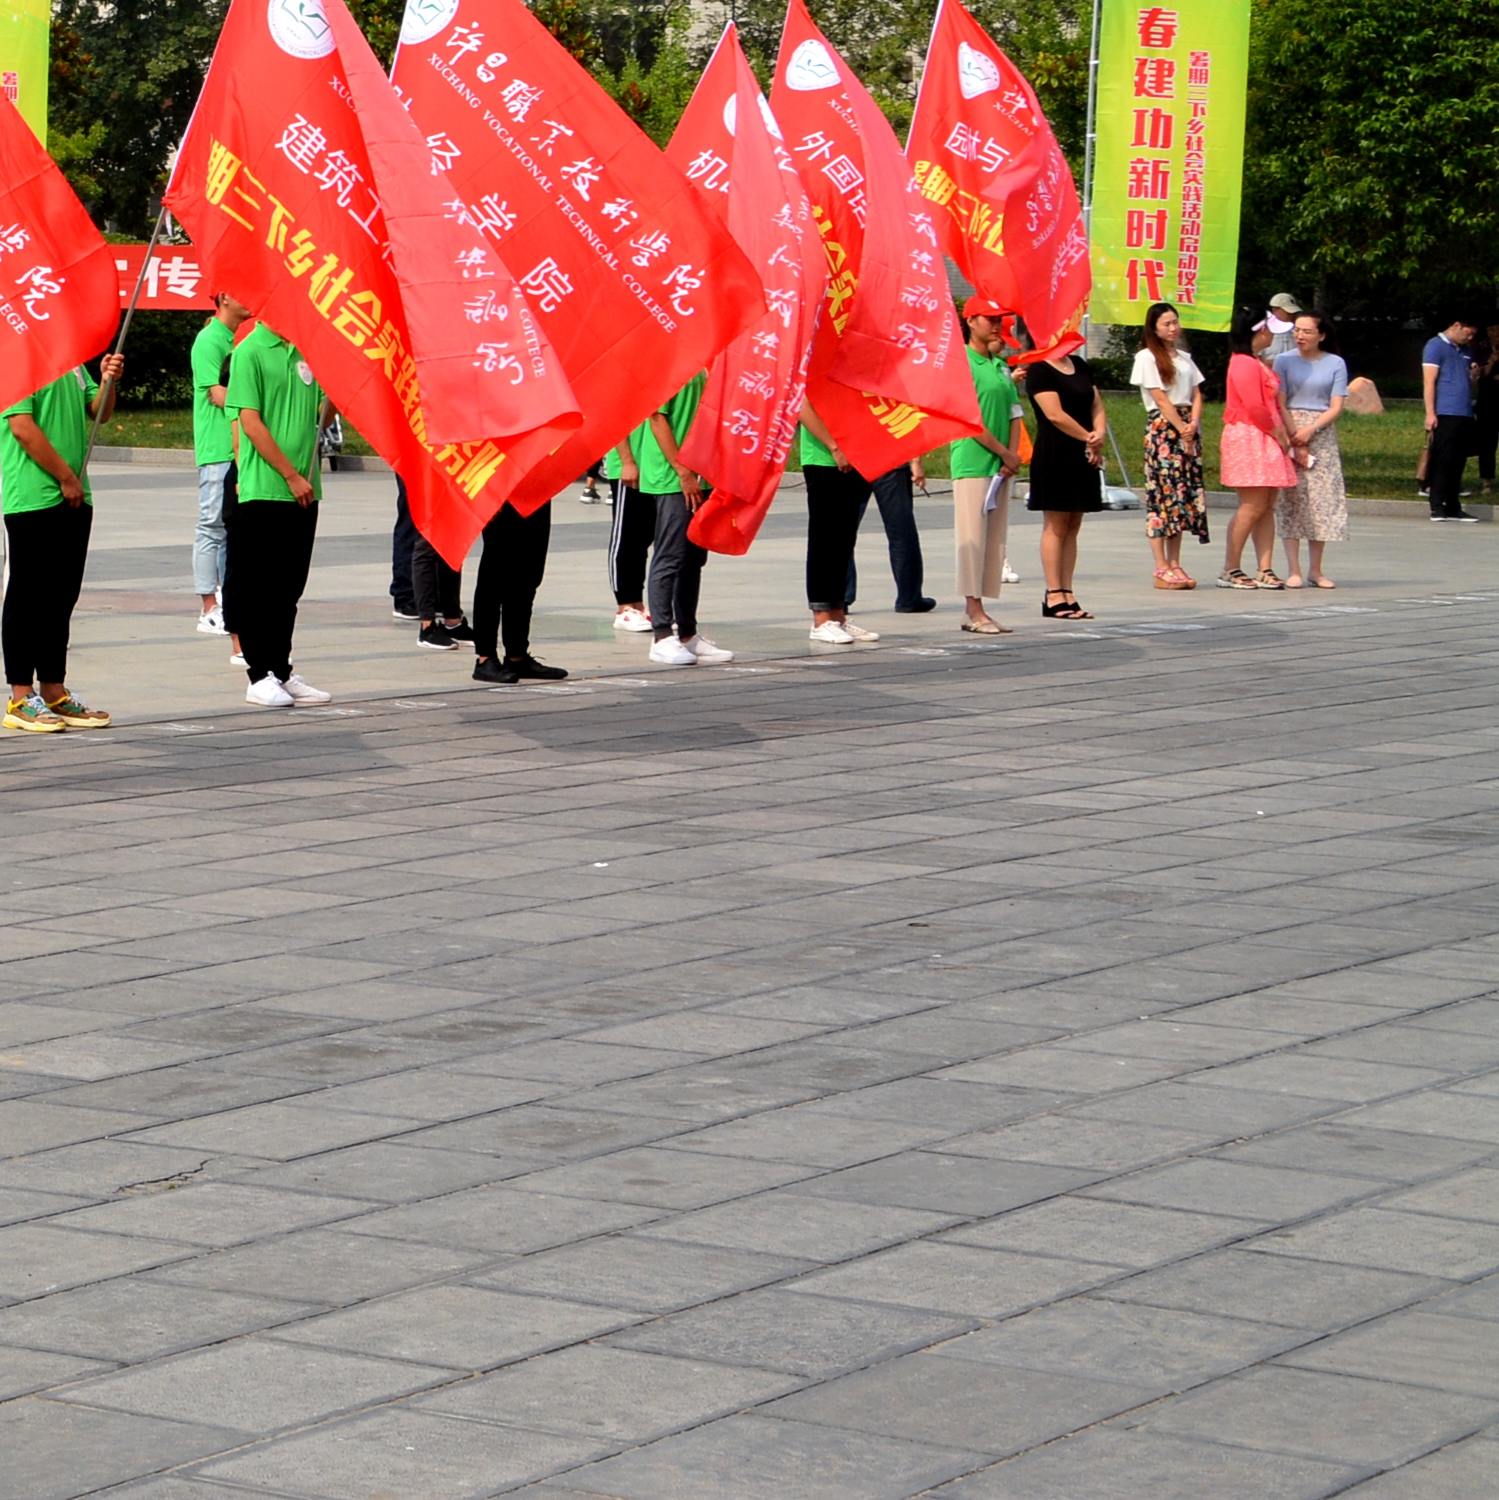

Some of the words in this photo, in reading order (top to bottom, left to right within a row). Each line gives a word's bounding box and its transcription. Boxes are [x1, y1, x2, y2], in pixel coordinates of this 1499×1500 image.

[426, 52, 482, 110] XUCHANG
[481, 109, 554, 194] VOCATIONAL
[554, 195, 619, 271] TECHNICAL
[621, 272, 678, 334] COLLEGE
[685, 149, 730, 193] 机
[1173, 49, 1212, 307] 暑期三下乡社会实践活动启动仪式
